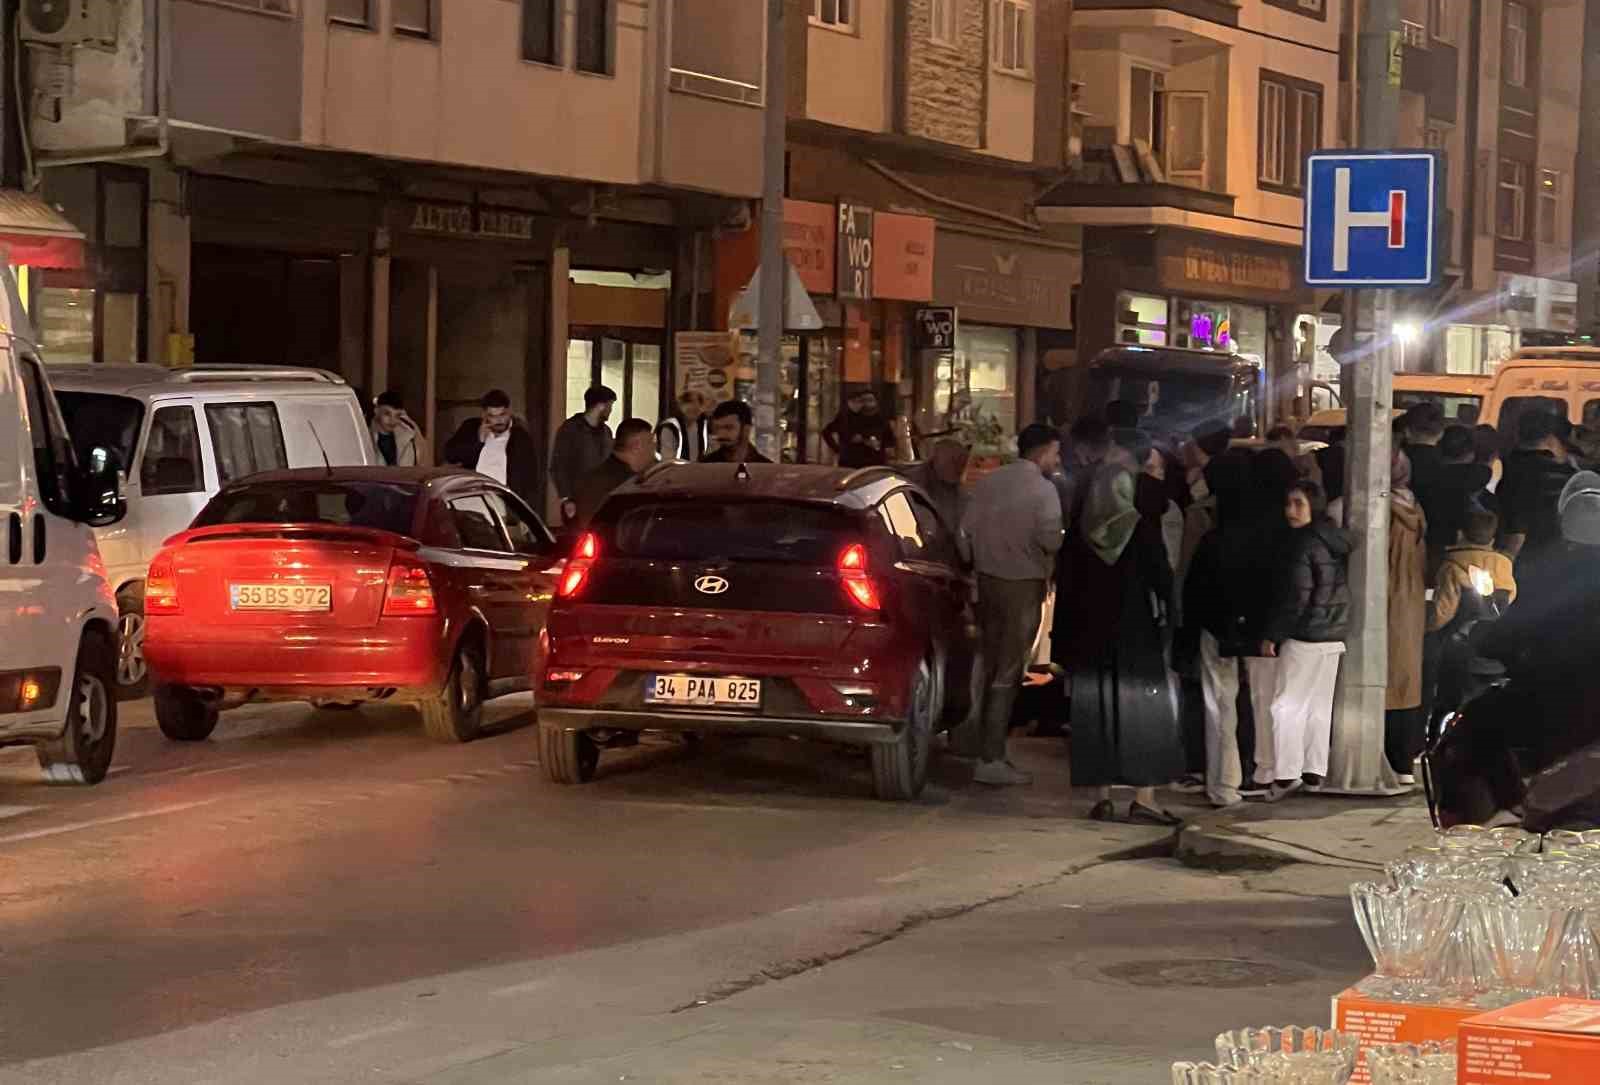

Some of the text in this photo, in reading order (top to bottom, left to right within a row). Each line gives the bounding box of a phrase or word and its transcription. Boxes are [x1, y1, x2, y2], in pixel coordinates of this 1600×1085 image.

[839, 203, 856, 234] FA
[848, 236, 872, 269] WO
[855, 269, 869, 299] RI
[926, 320, 952, 335] WO
[240, 587, 261, 603] 55
[265, 588, 289, 604] BS
[294, 588, 328, 604] 972
[656, 678, 675, 697] 34
[687, 680, 716, 699] PAA
[727, 682, 758, 700] 825
